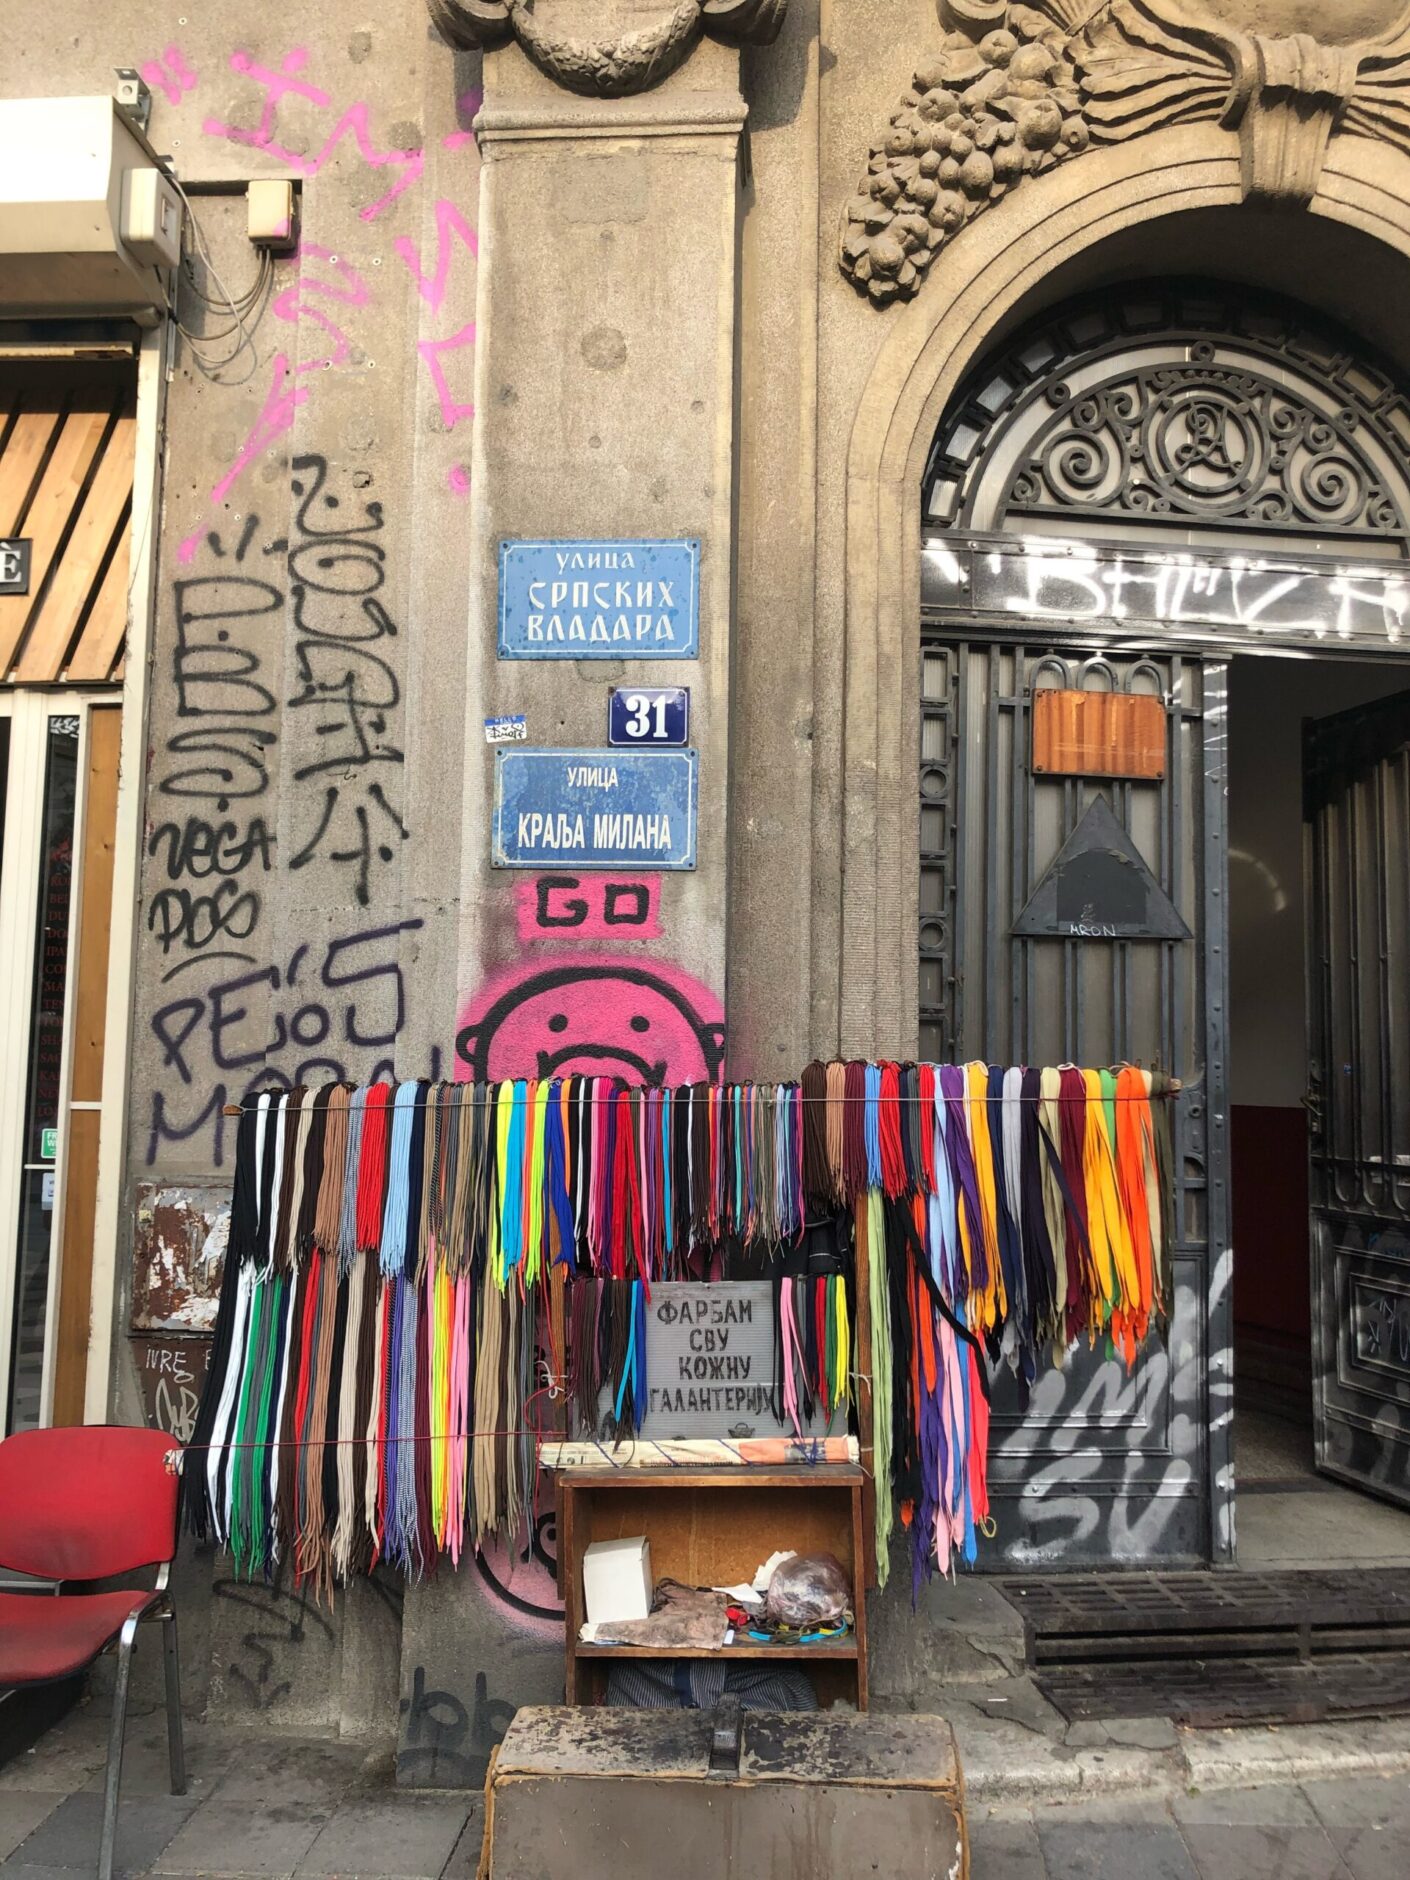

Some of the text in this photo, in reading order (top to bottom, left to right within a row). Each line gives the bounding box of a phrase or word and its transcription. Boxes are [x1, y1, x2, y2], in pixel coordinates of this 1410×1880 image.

[528, 580, 675, 610] СРПСКИХ
[527, 613, 676, 644] ВЛАДАРА
[625, 694, 669, 738] 31
[567, 766, 620, 793] УЛИЦА
[517, 812, 673, 850] КРАЉА МИЛАНА
[656, 1299, 752, 1325] ФАРБАМ
[689, 1327, 730, 1352] СВУ
[678, 1355, 752, 1380] КОЖНУ
